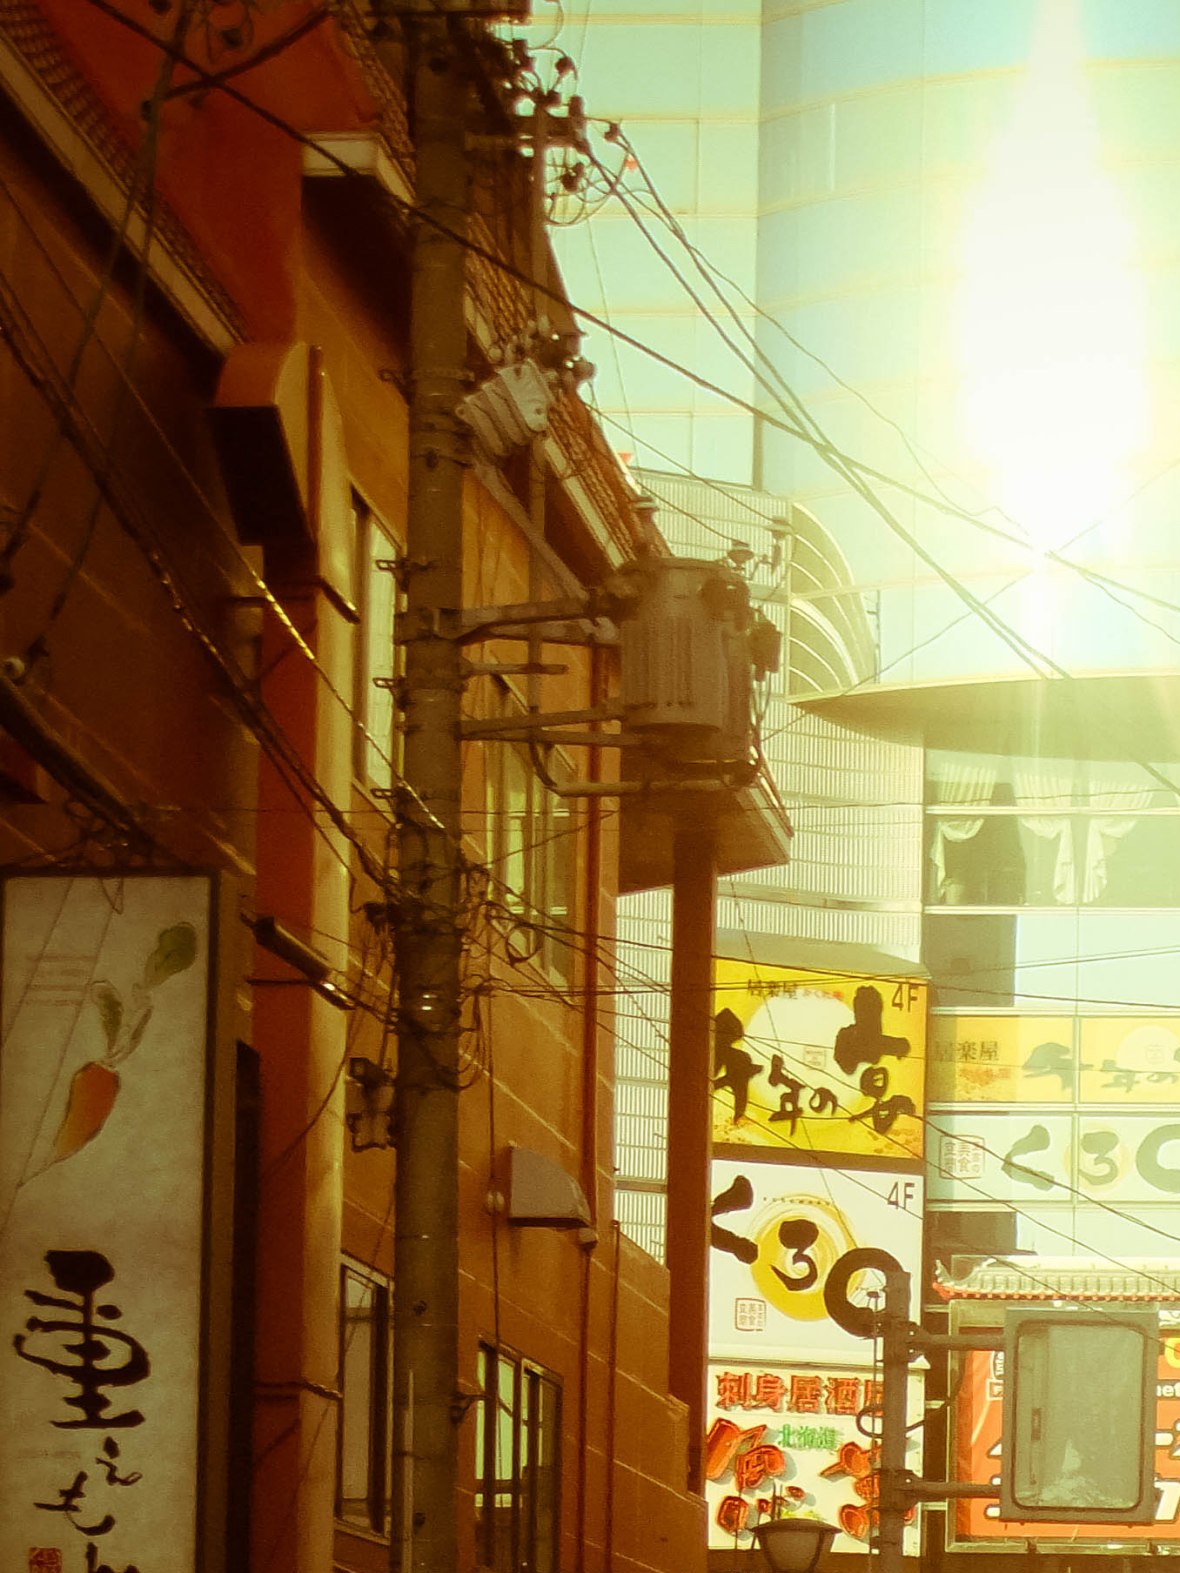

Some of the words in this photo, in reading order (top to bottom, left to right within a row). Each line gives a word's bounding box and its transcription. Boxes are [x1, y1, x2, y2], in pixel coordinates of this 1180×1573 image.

[891, 983, 919, 1013] 4F
[887, 1181, 915, 1210] 4F
[778, 1423, 838, 1450] 北海道
